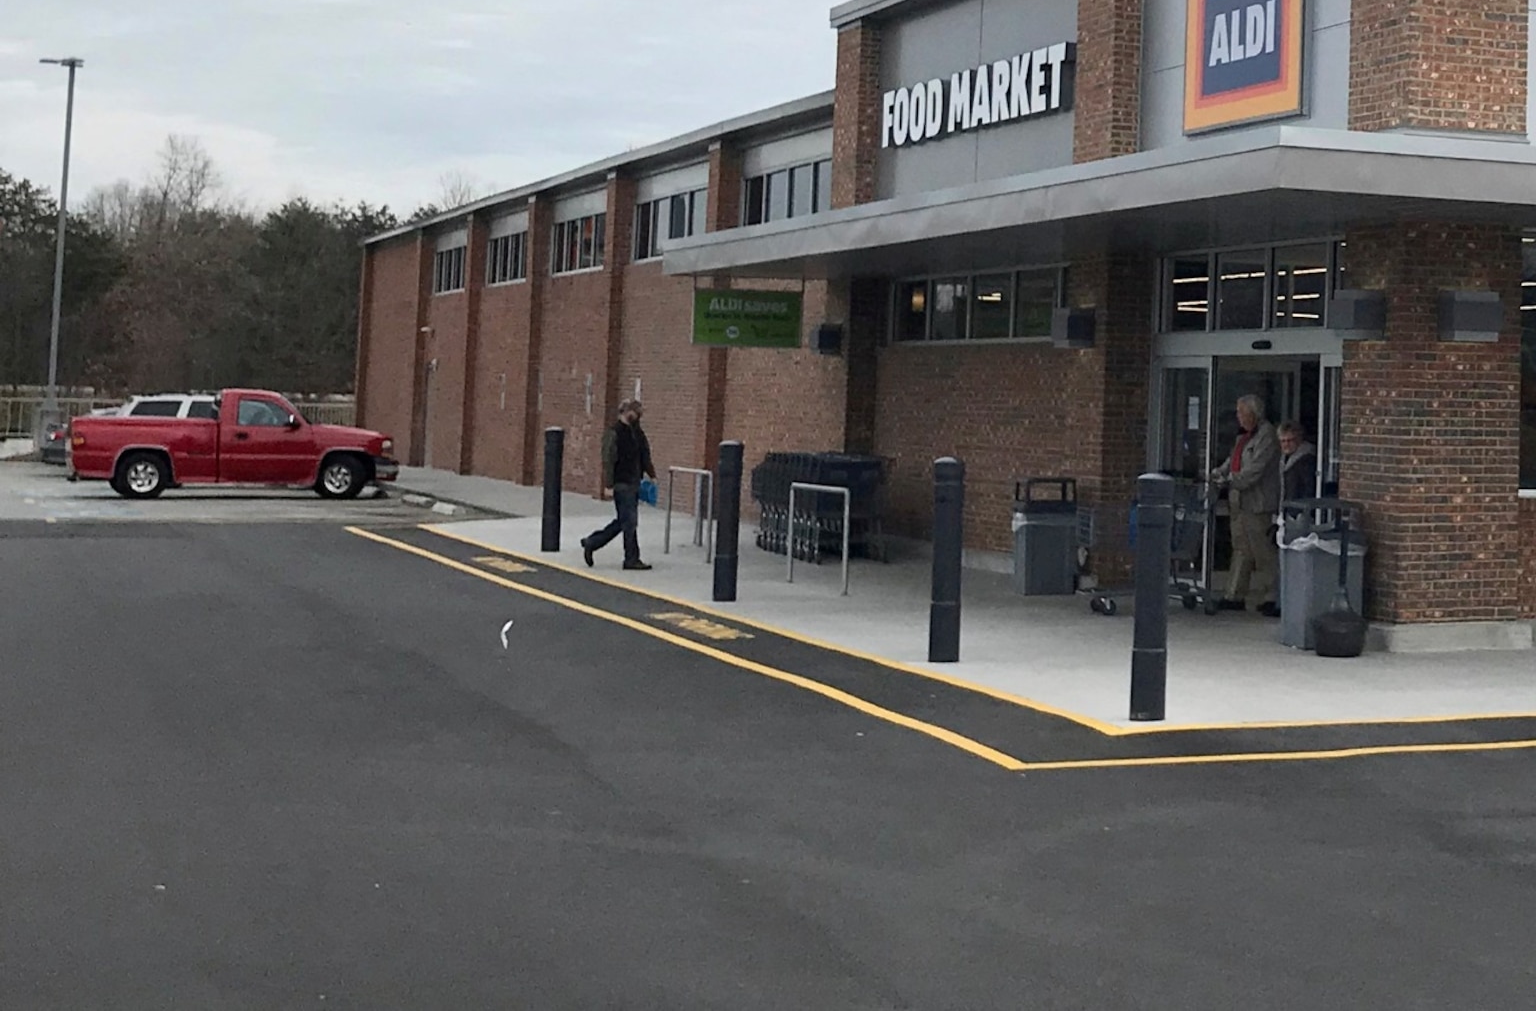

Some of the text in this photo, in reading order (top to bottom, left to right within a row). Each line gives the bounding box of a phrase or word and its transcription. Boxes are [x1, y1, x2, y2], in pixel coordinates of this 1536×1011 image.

[881, 41, 1068, 149] FOOD MARKET
[709, 297, 743, 311] ALDI
